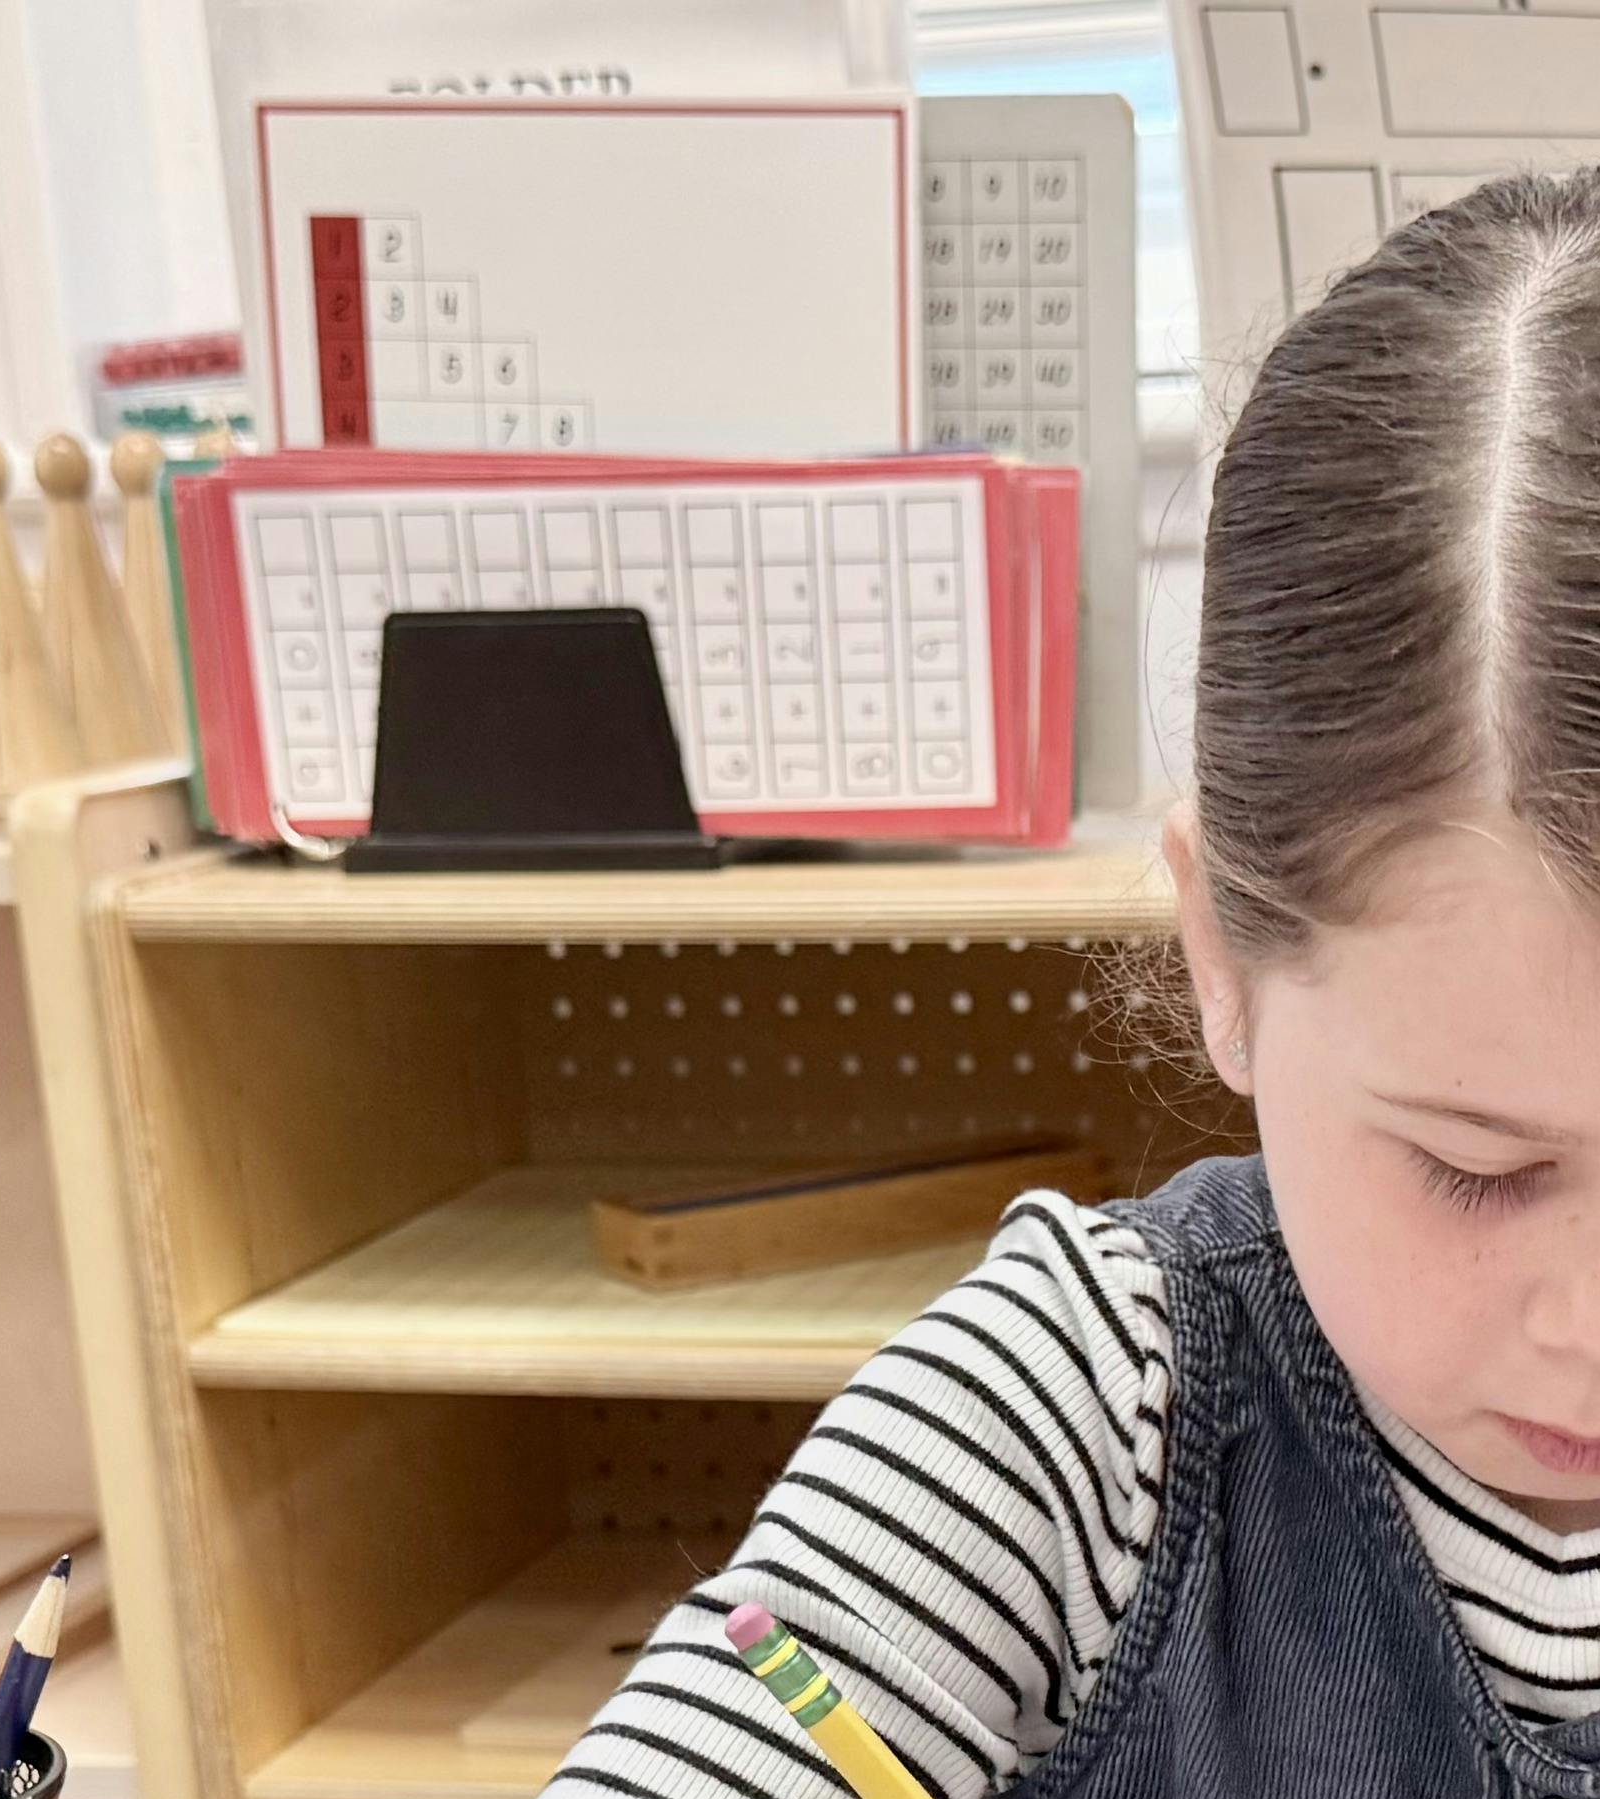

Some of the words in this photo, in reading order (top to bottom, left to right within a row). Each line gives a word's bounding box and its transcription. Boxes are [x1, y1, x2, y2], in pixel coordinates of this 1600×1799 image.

[379, 224, 401, 264] 2
[436, 288, 458, 325] 4
[440, 347, 463, 385] 5
[494, 350, 516, 386] 6
[498, 410, 519, 446] 7
